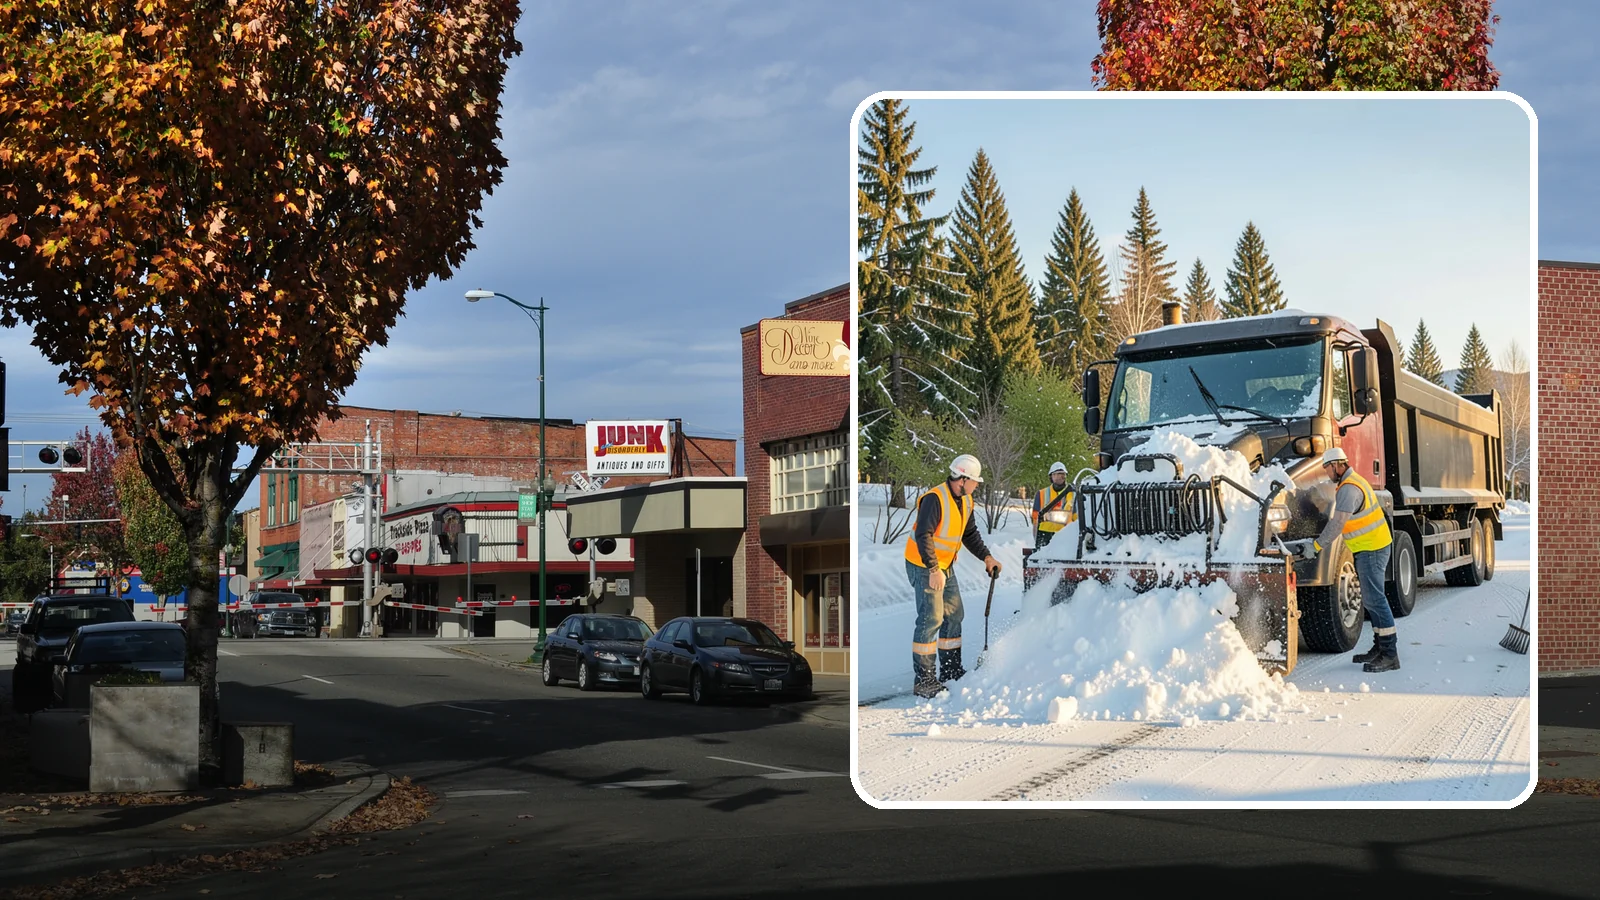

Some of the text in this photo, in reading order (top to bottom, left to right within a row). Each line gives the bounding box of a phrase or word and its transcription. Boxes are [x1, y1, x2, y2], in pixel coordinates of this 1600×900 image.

[595, 425, 665, 457] JUNK
[607, 446, 646, 454] DISORDERLY
[597, 460, 665, 470] ANTIQUES AND GIFTS
[390, 519, 429, 540] Trackside Pizza
